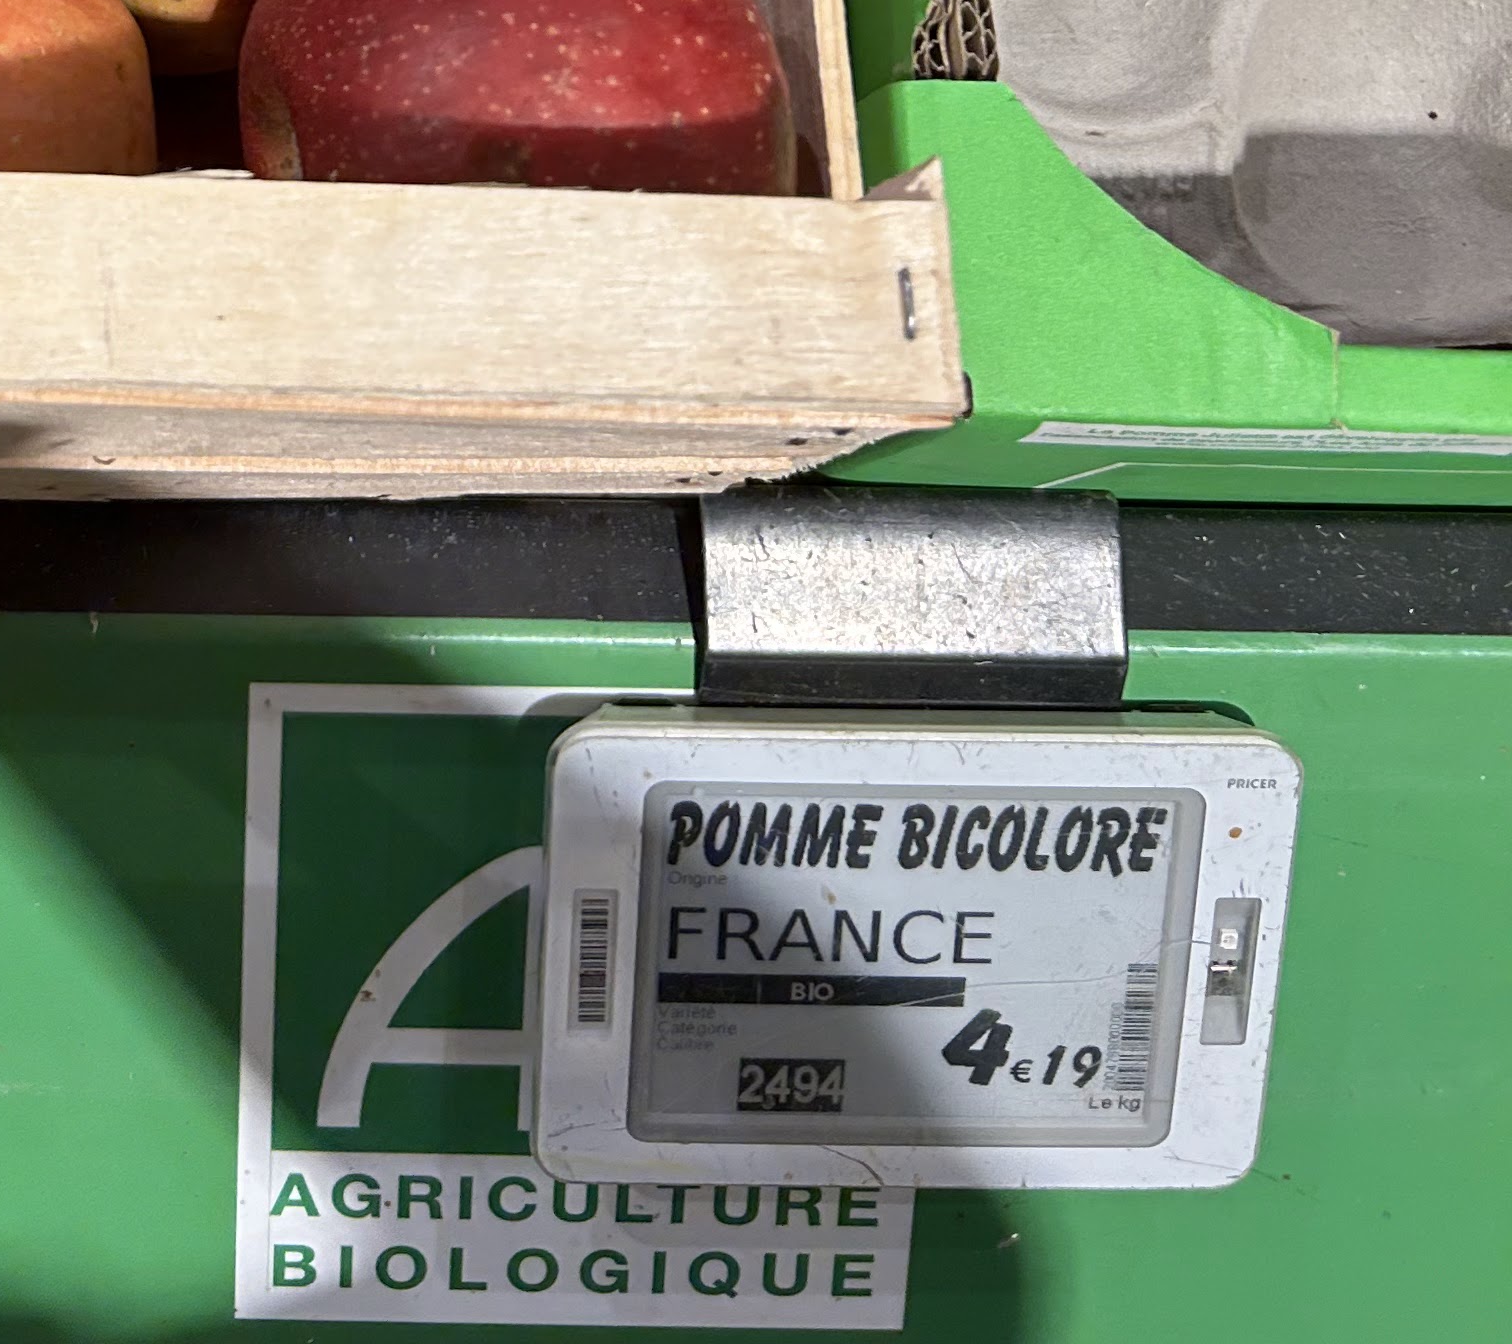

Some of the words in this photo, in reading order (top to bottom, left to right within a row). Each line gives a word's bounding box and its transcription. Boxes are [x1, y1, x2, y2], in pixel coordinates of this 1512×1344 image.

[1227, 778, 1277, 789] PRICER
[667, 800, 884, 868] POMME
[898, 803, 1168, 877] BICOLORE
[668, 870, 727, 888] Origine
[667, 906, 995, 965] FRANCE
[790, 981, 835, 1002] BIO
[739, 1064, 845, 1105] 2494
[1088, 1096, 1112, 1110] Le
[1118, 1095, 1142, 1112] kg
[269, 1172, 882, 1227] AGRICULTURE
[272, 1244, 875, 1299] BIOLOGIQUE
